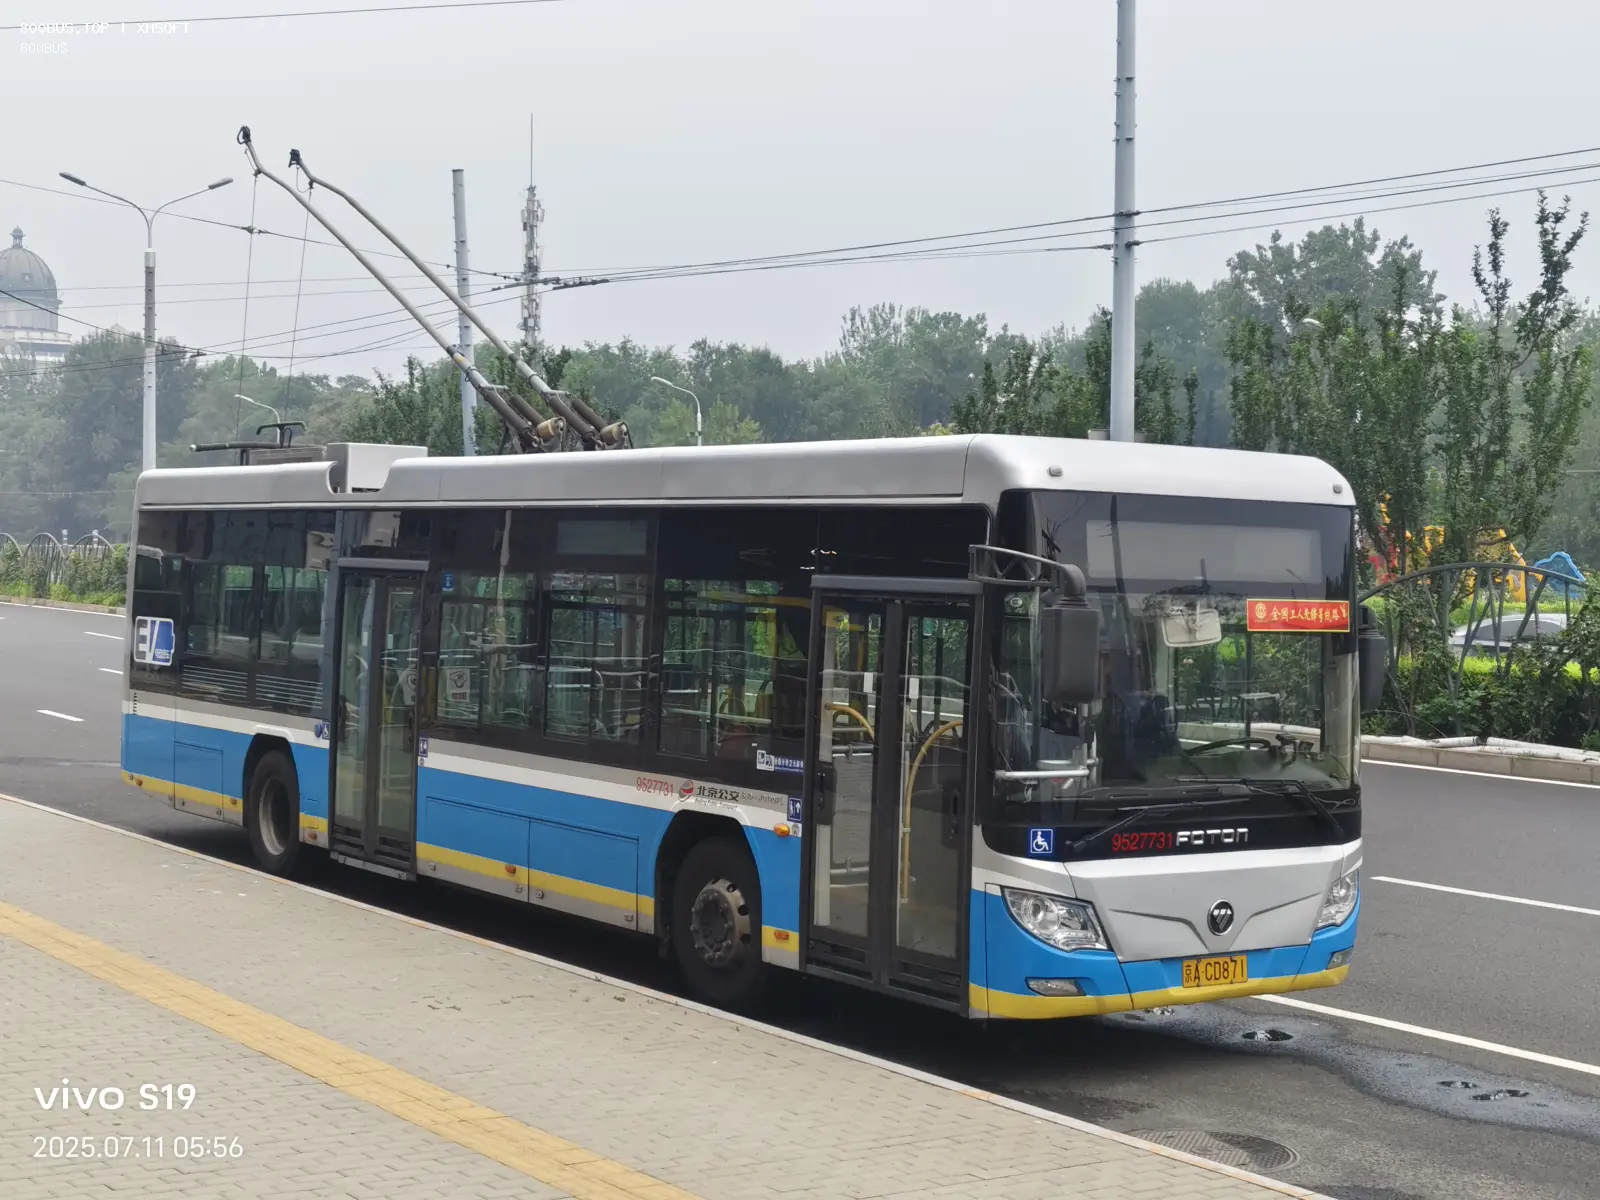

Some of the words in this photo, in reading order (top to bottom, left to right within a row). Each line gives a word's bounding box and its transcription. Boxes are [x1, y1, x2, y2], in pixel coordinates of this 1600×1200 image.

[636, 776, 675, 797] 9527731
[696, 785, 740, 802] 北京公交
[1111, 831, 1173, 852] 9527731
[1175, 828, 1249, 847] FOTON
